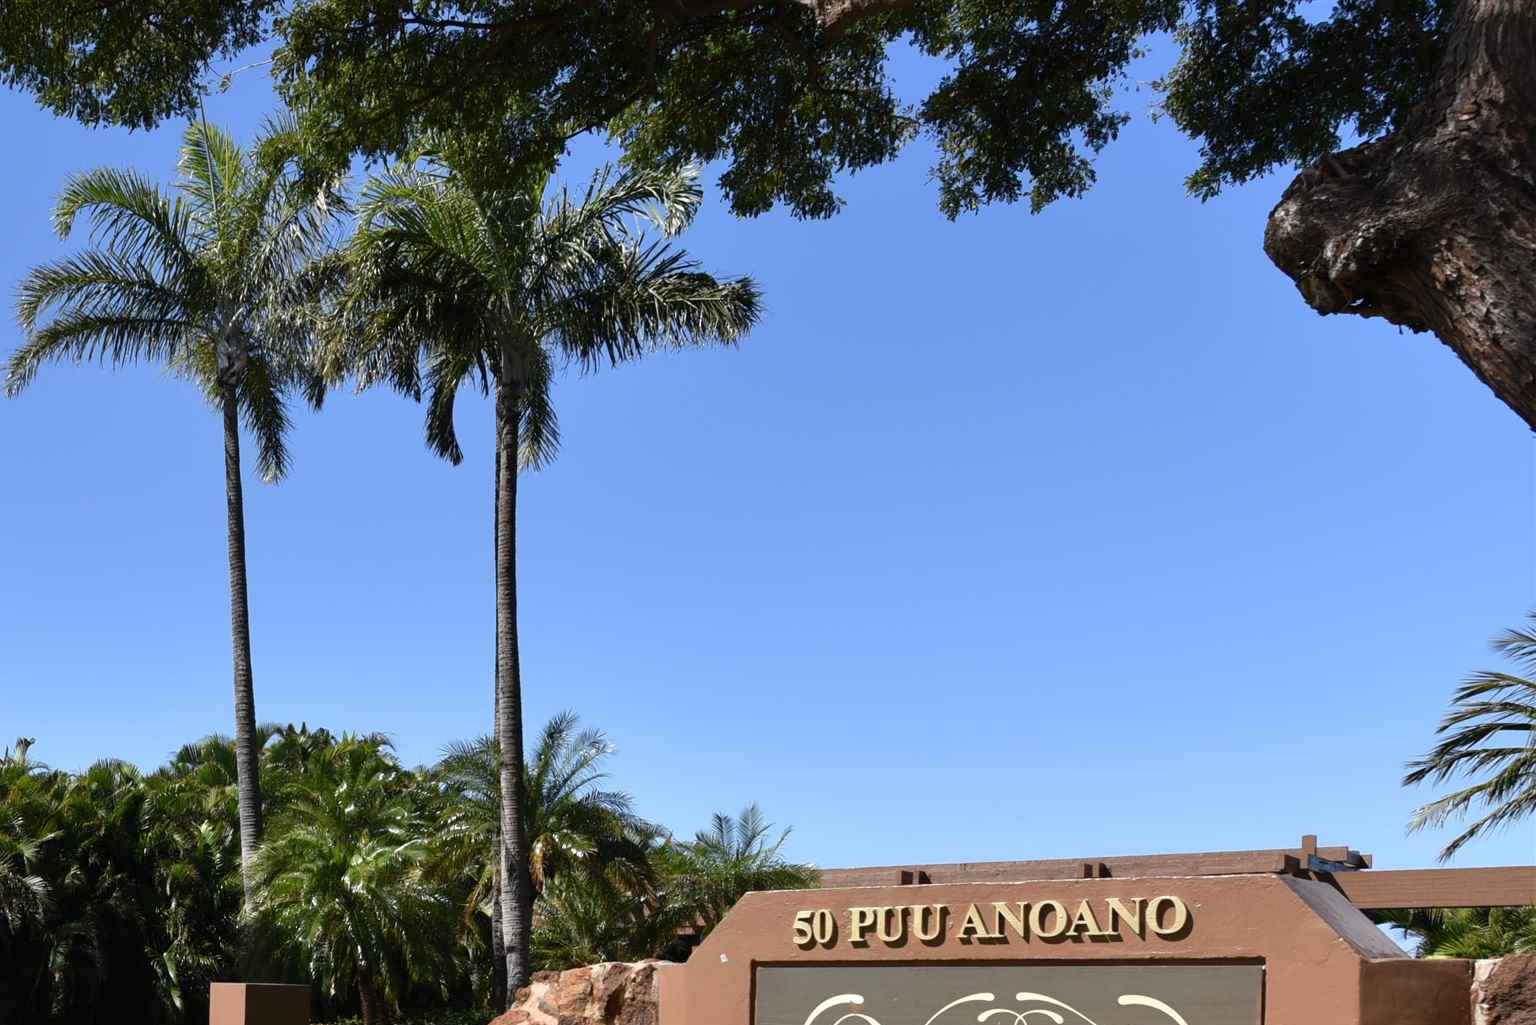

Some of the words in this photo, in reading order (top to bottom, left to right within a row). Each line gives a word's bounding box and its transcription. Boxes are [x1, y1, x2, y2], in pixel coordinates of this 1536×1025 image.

[791, 908, 835, 946] 50
[847, 903, 948, 943] PUU
[957, 895, 1189, 939] ANOANO
